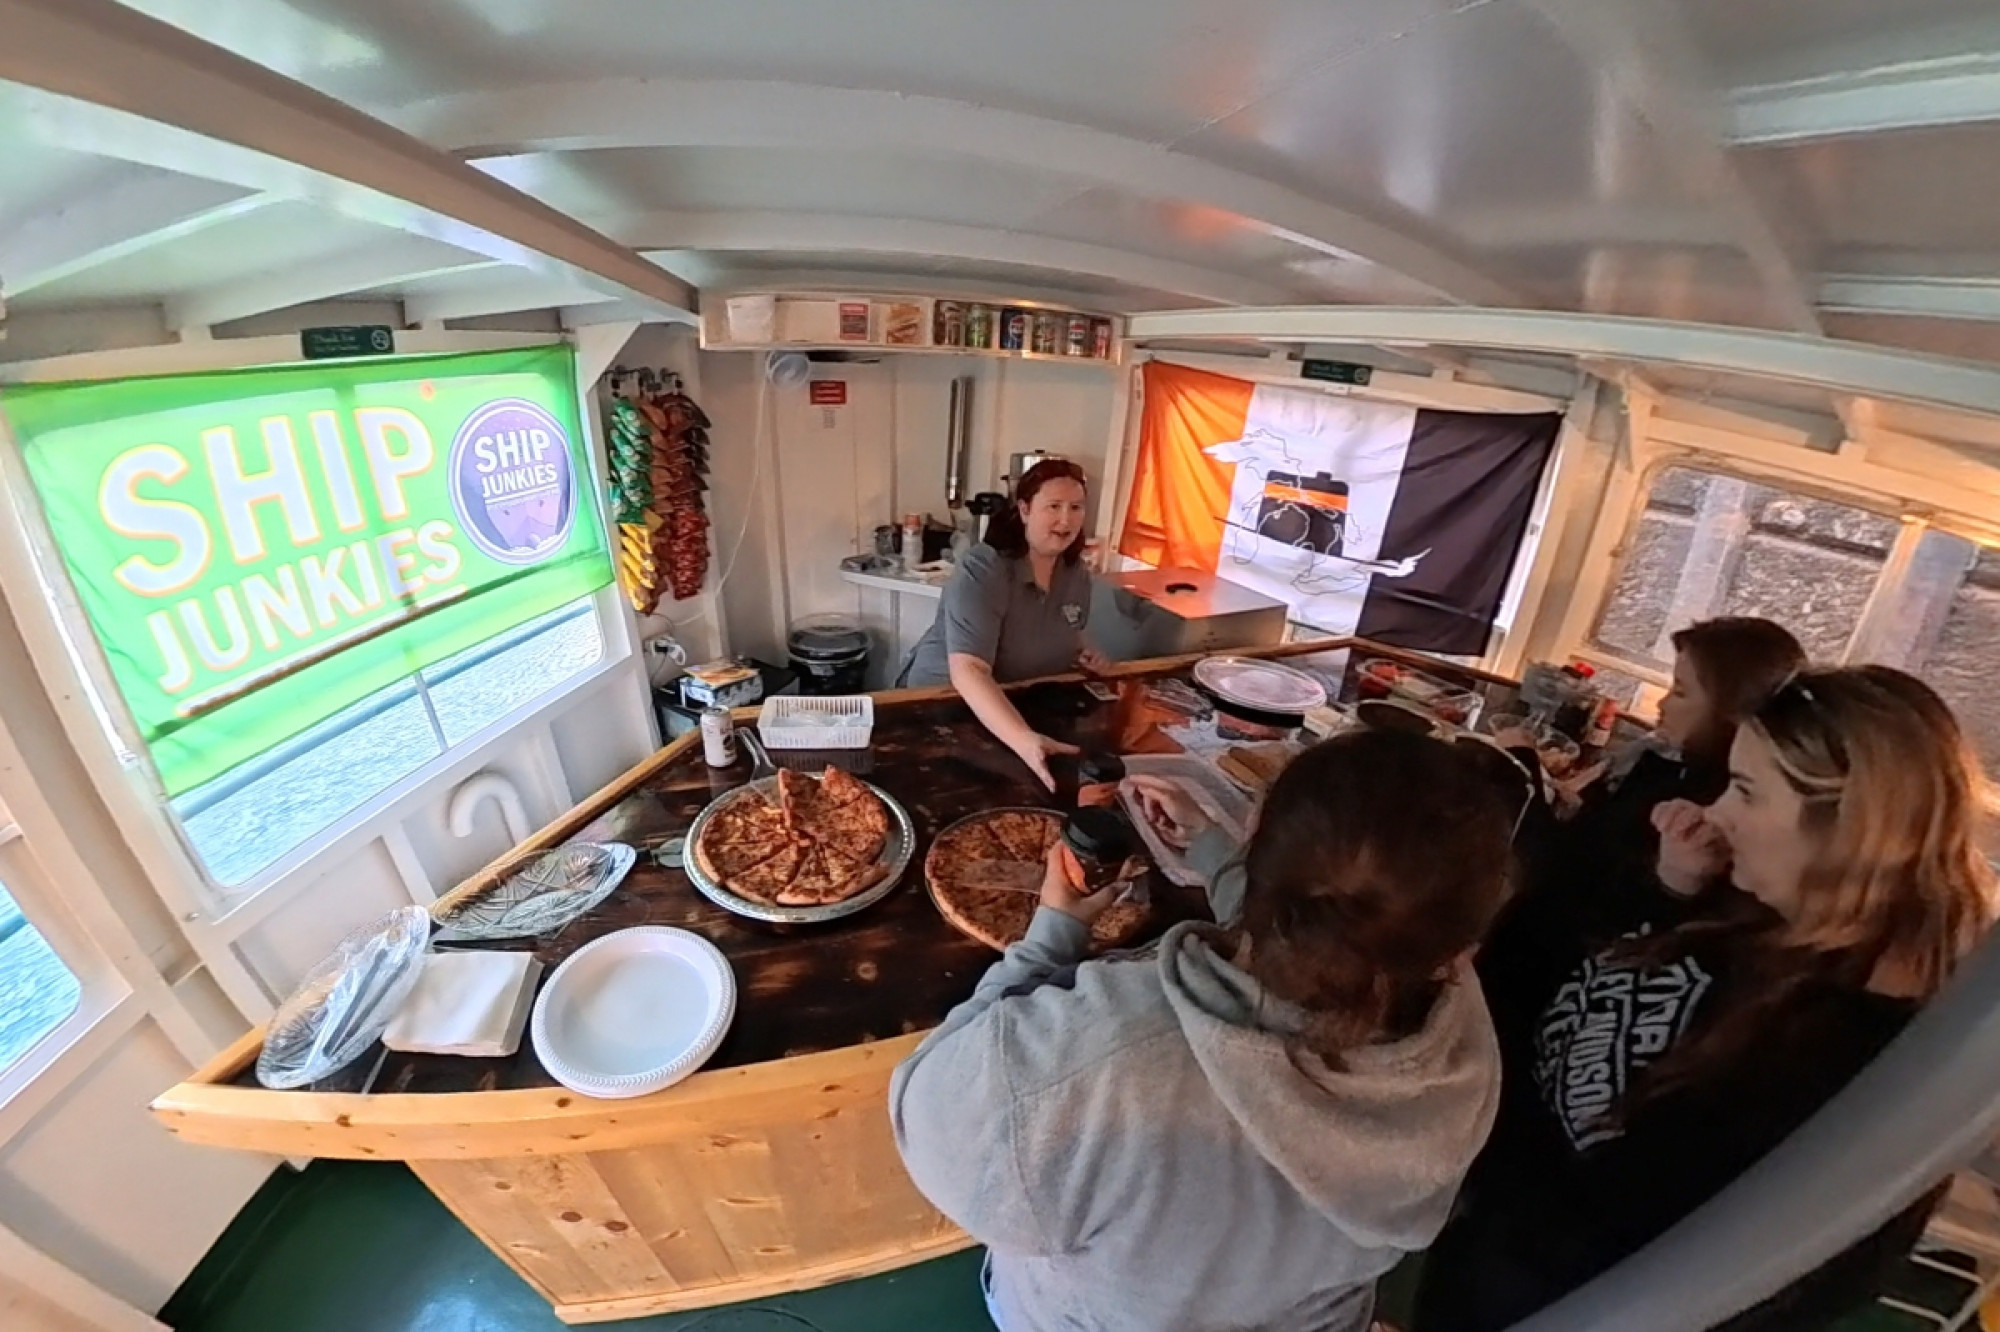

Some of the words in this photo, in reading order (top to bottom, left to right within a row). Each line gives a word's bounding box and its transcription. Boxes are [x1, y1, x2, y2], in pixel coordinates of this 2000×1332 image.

[99, 407, 435, 596] SHIP
[474, 429, 550, 473] SHIP
[481, 463, 558, 498] JUNKIES
[146, 519, 463, 694] JUNKIES
